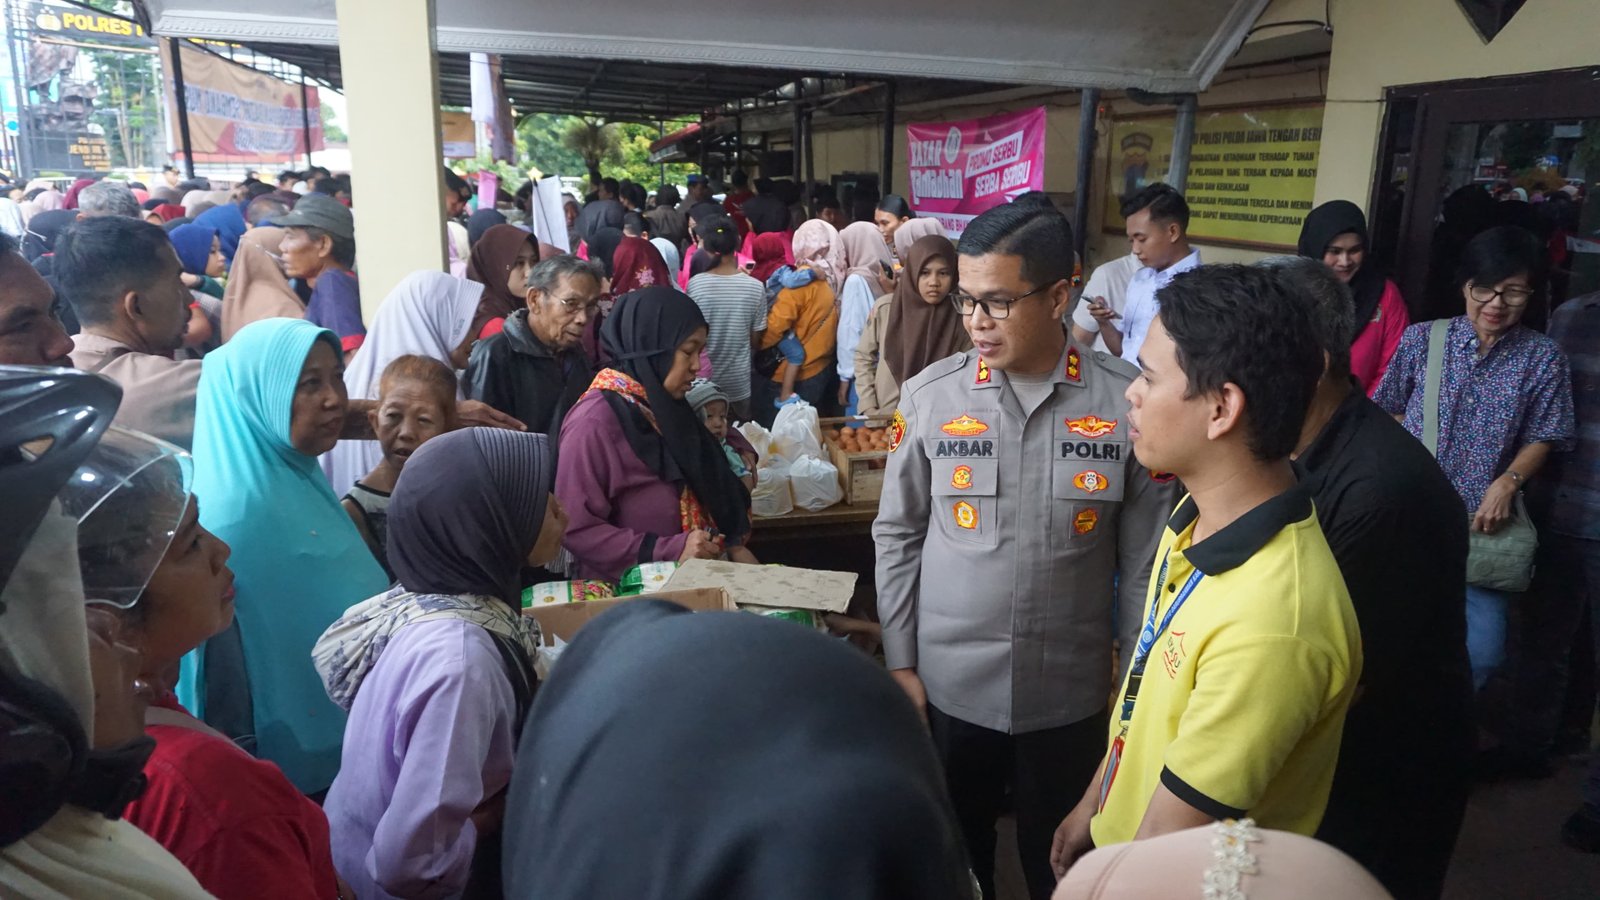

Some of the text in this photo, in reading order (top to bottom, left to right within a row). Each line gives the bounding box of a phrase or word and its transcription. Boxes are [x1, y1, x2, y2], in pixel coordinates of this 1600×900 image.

[63, 12, 132, 36] POLRES
[1269, 128, 1300, 142] TENGAH
[992, 138, 1019, 164] SERBU
[1293, 151, 1314, 161] TUHAN
[1270, 167, 1294, 177] KEPADA
[975, 170, 1000, 198] SERBA
[1250, 198, 1275, 208] TERCELA
[1276, 200, 1289, 209] DAN
[935, 440, 993, 457] AKBAR
[1061, 441, 1120, 461] POLRI
